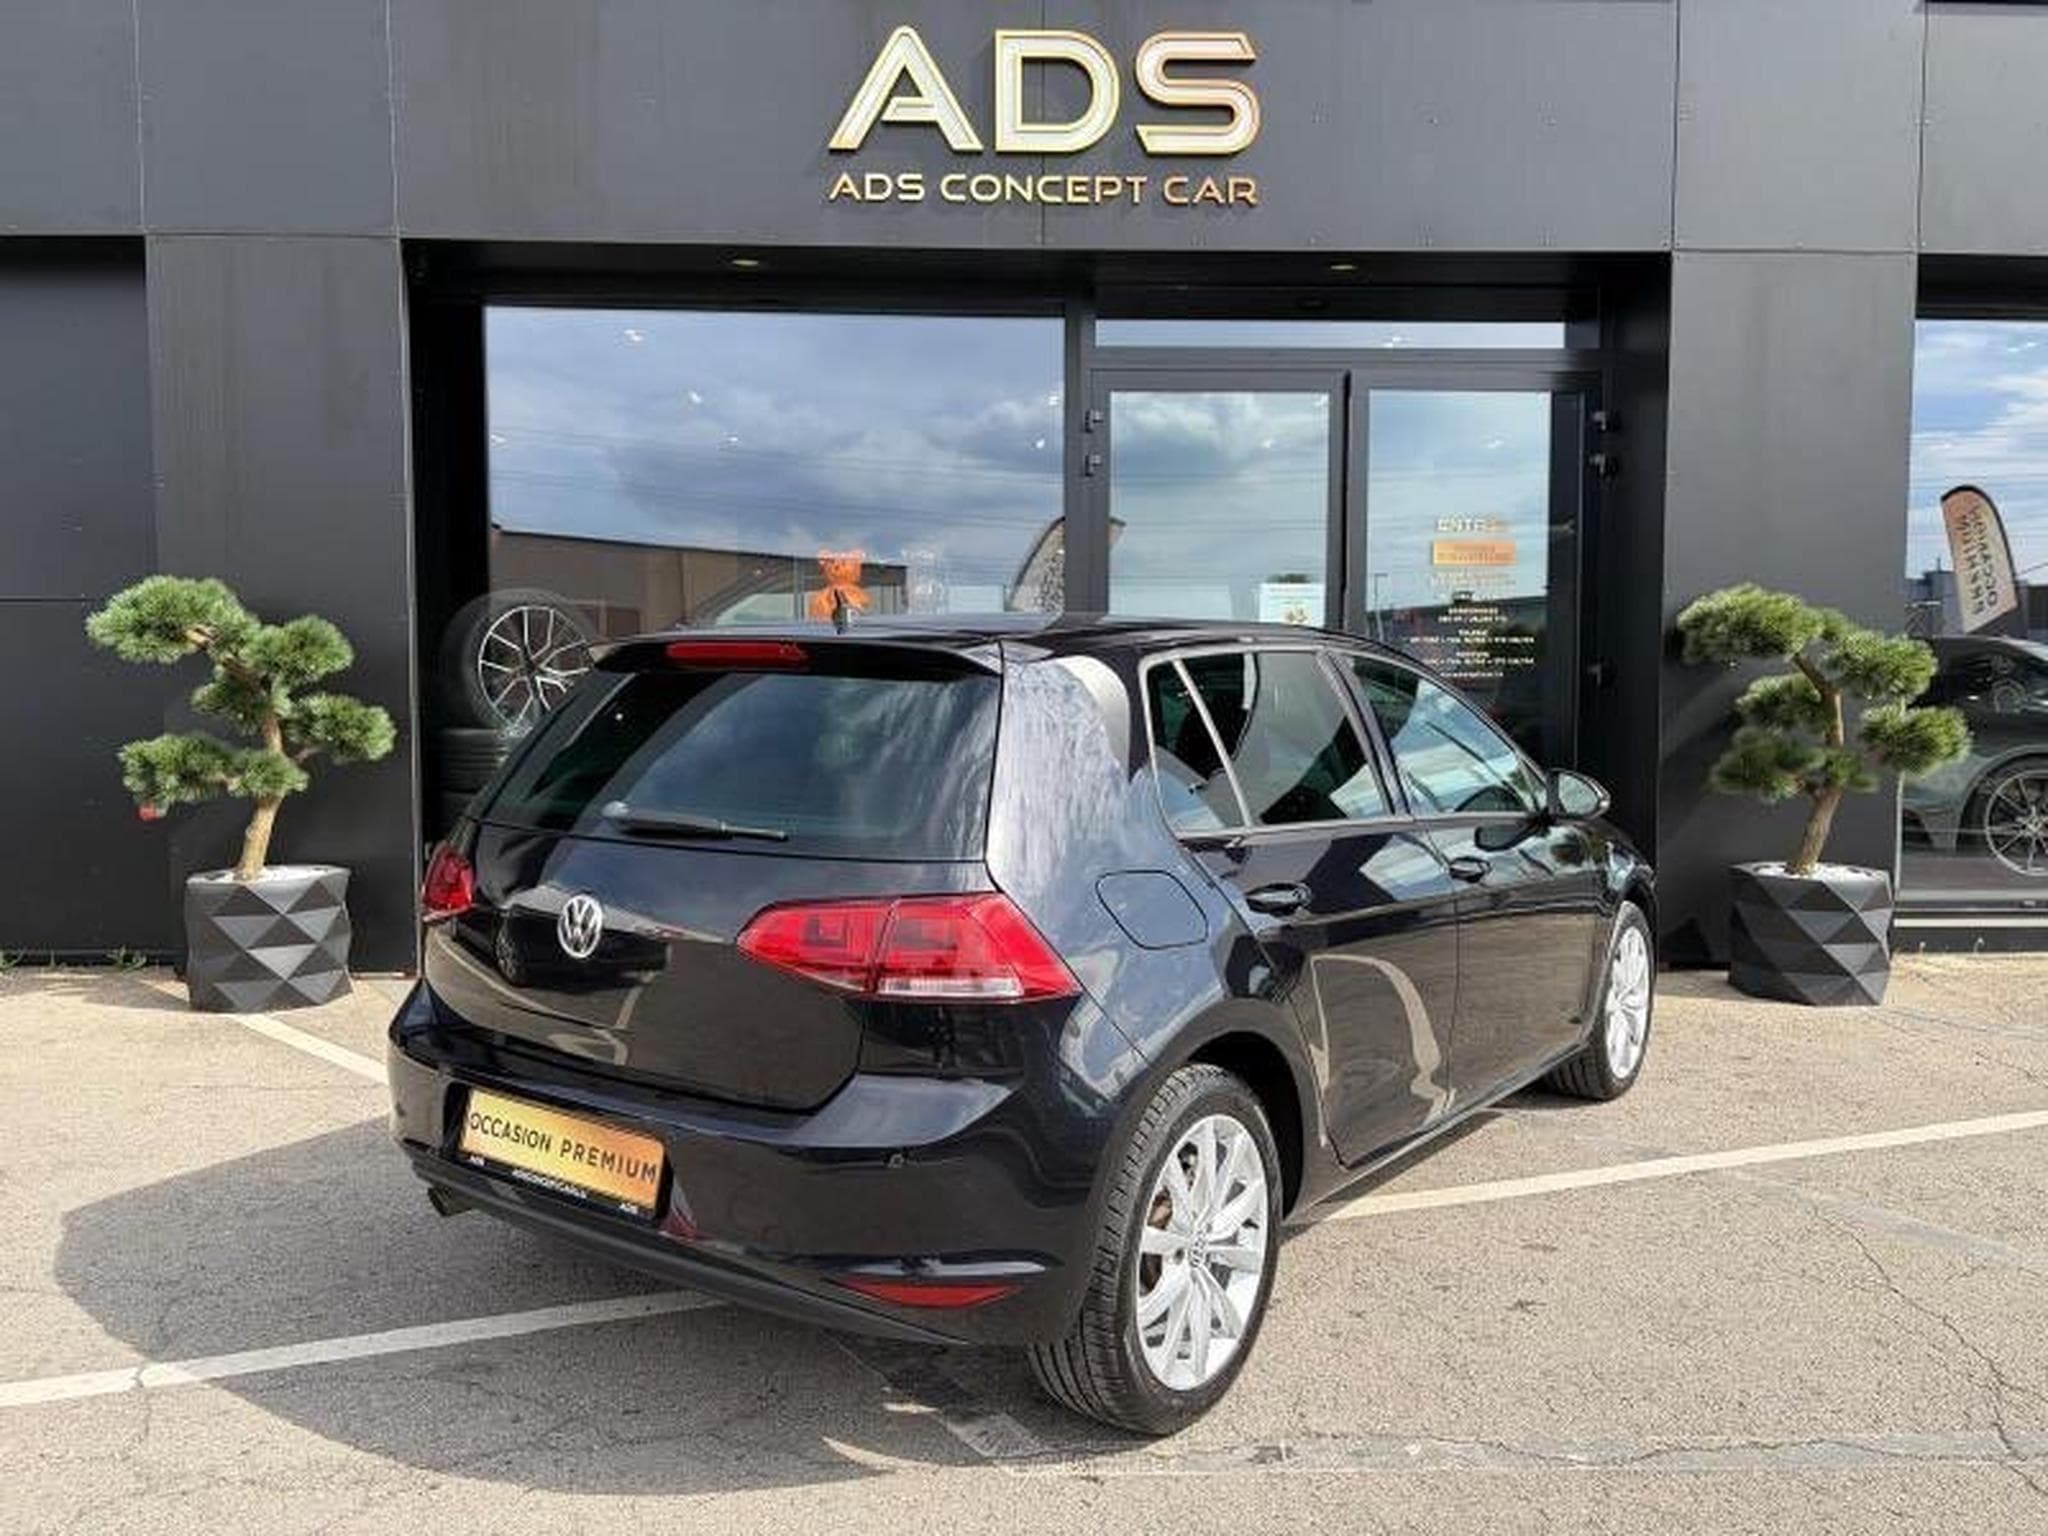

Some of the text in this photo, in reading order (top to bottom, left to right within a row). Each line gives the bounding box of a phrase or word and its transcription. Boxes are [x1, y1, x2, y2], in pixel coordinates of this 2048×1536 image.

[828, 25, 1261, 154] ADS
[829, 172, 1258, 205] ADS CONCEPT CAR
[469, 1112, 551, 1154] OCCASION
[560, 1138, 657, 1184] PREMIUM
